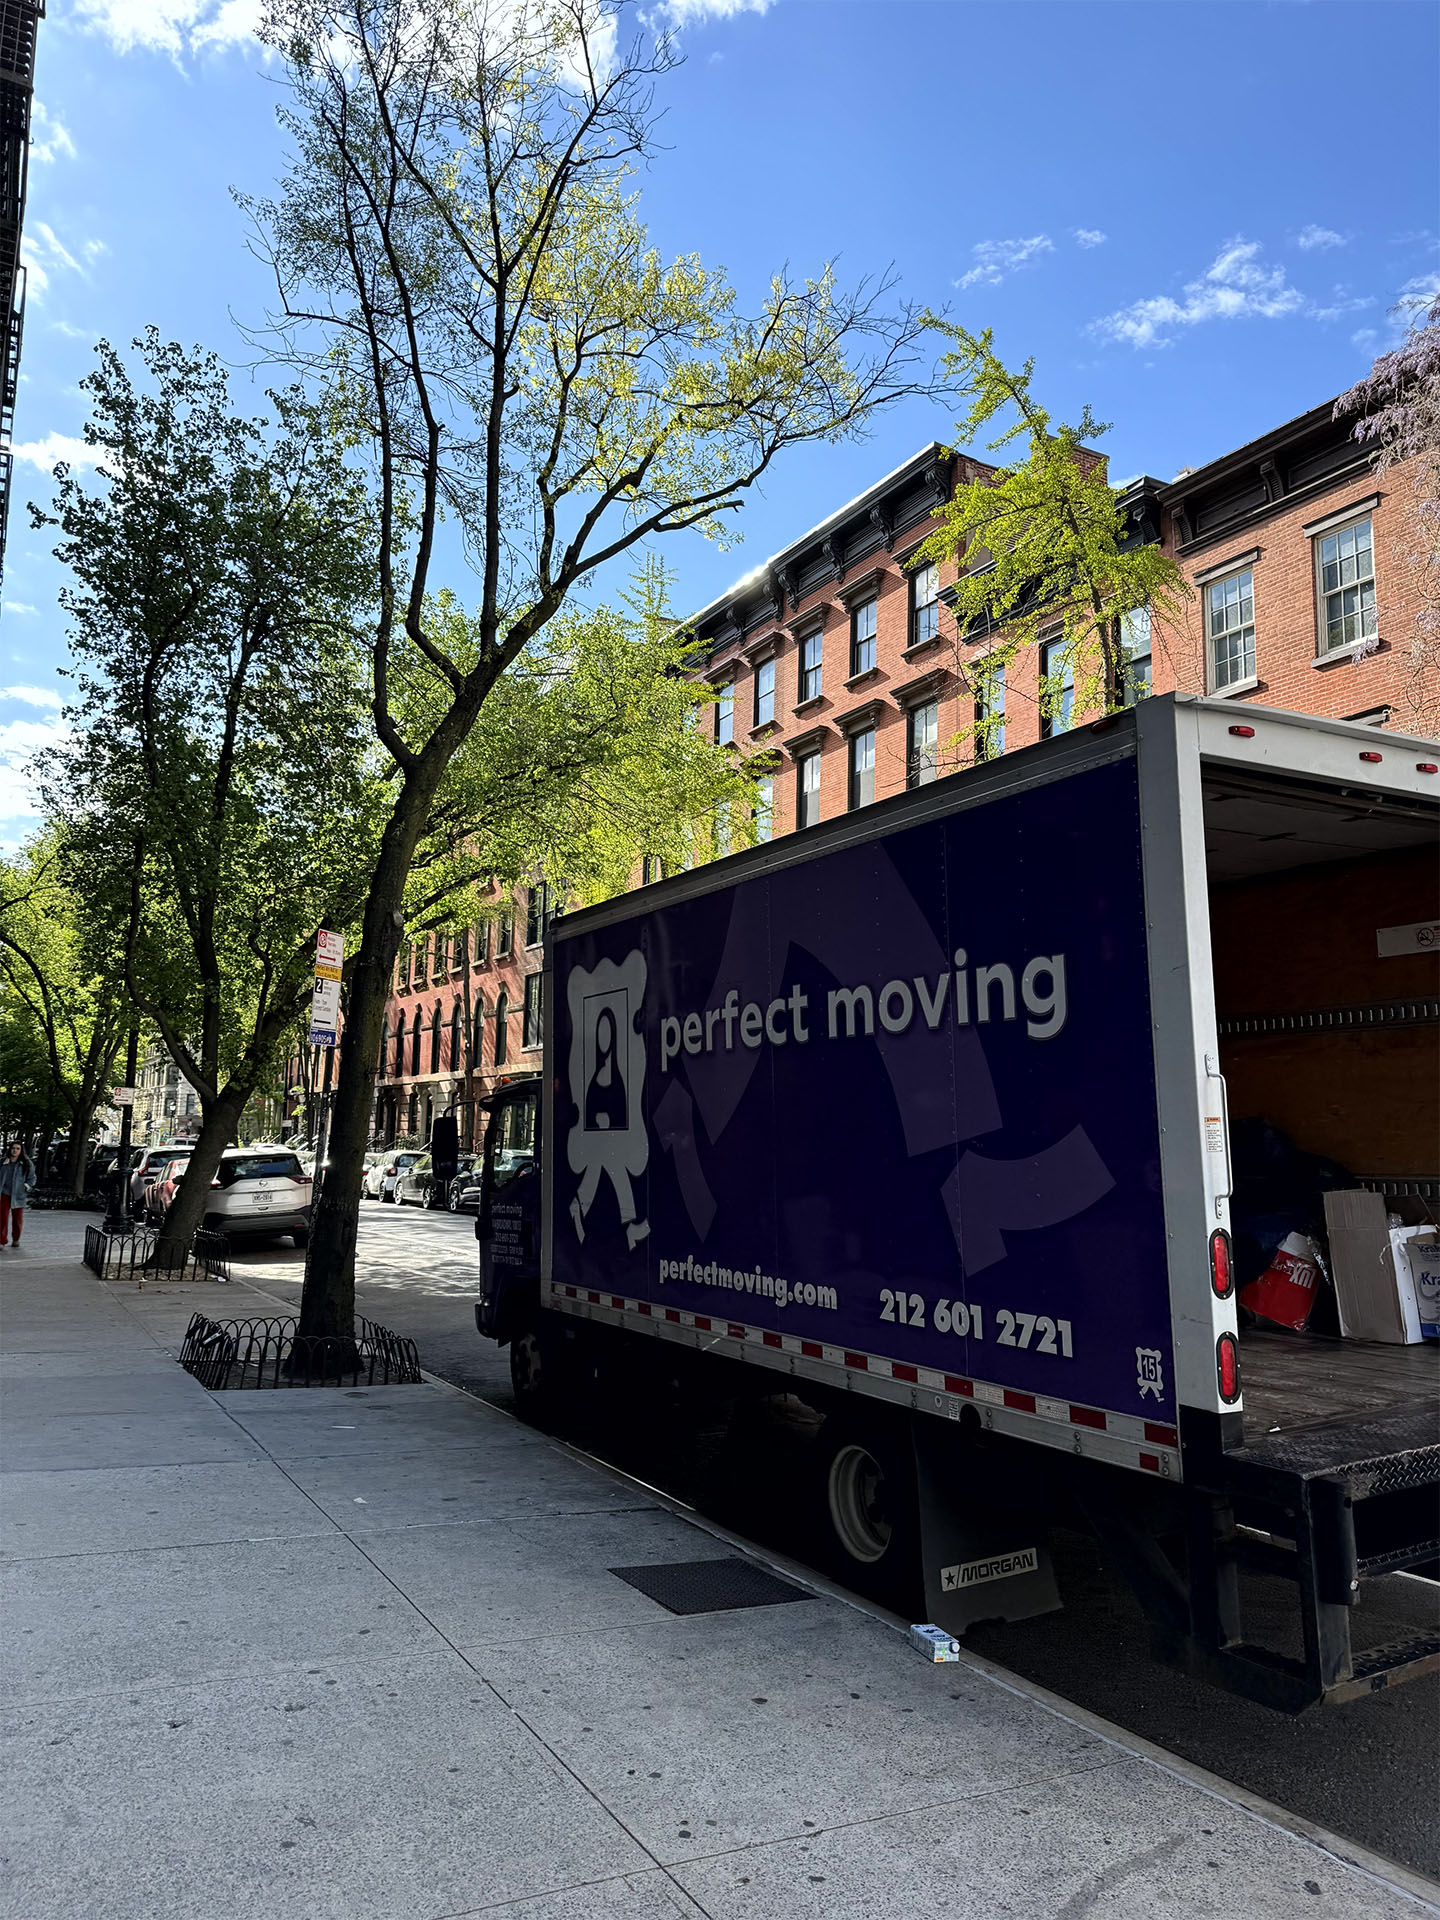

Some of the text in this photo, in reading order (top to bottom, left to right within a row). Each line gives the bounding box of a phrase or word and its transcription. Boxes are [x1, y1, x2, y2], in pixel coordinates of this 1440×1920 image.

[316, 979, 321, 991] 2
[661, 948, 1067, 1072] perfect moving
[506, 1202, 522, 1217] moving
[659, 1256, 838, 1308] perfectmoving.com
[879, 1288, 1073, 1358] 212 601 2721
[1142, 1356, 1156, 1380] 15
[961, 1553, 1033, 1583] MORGAN
